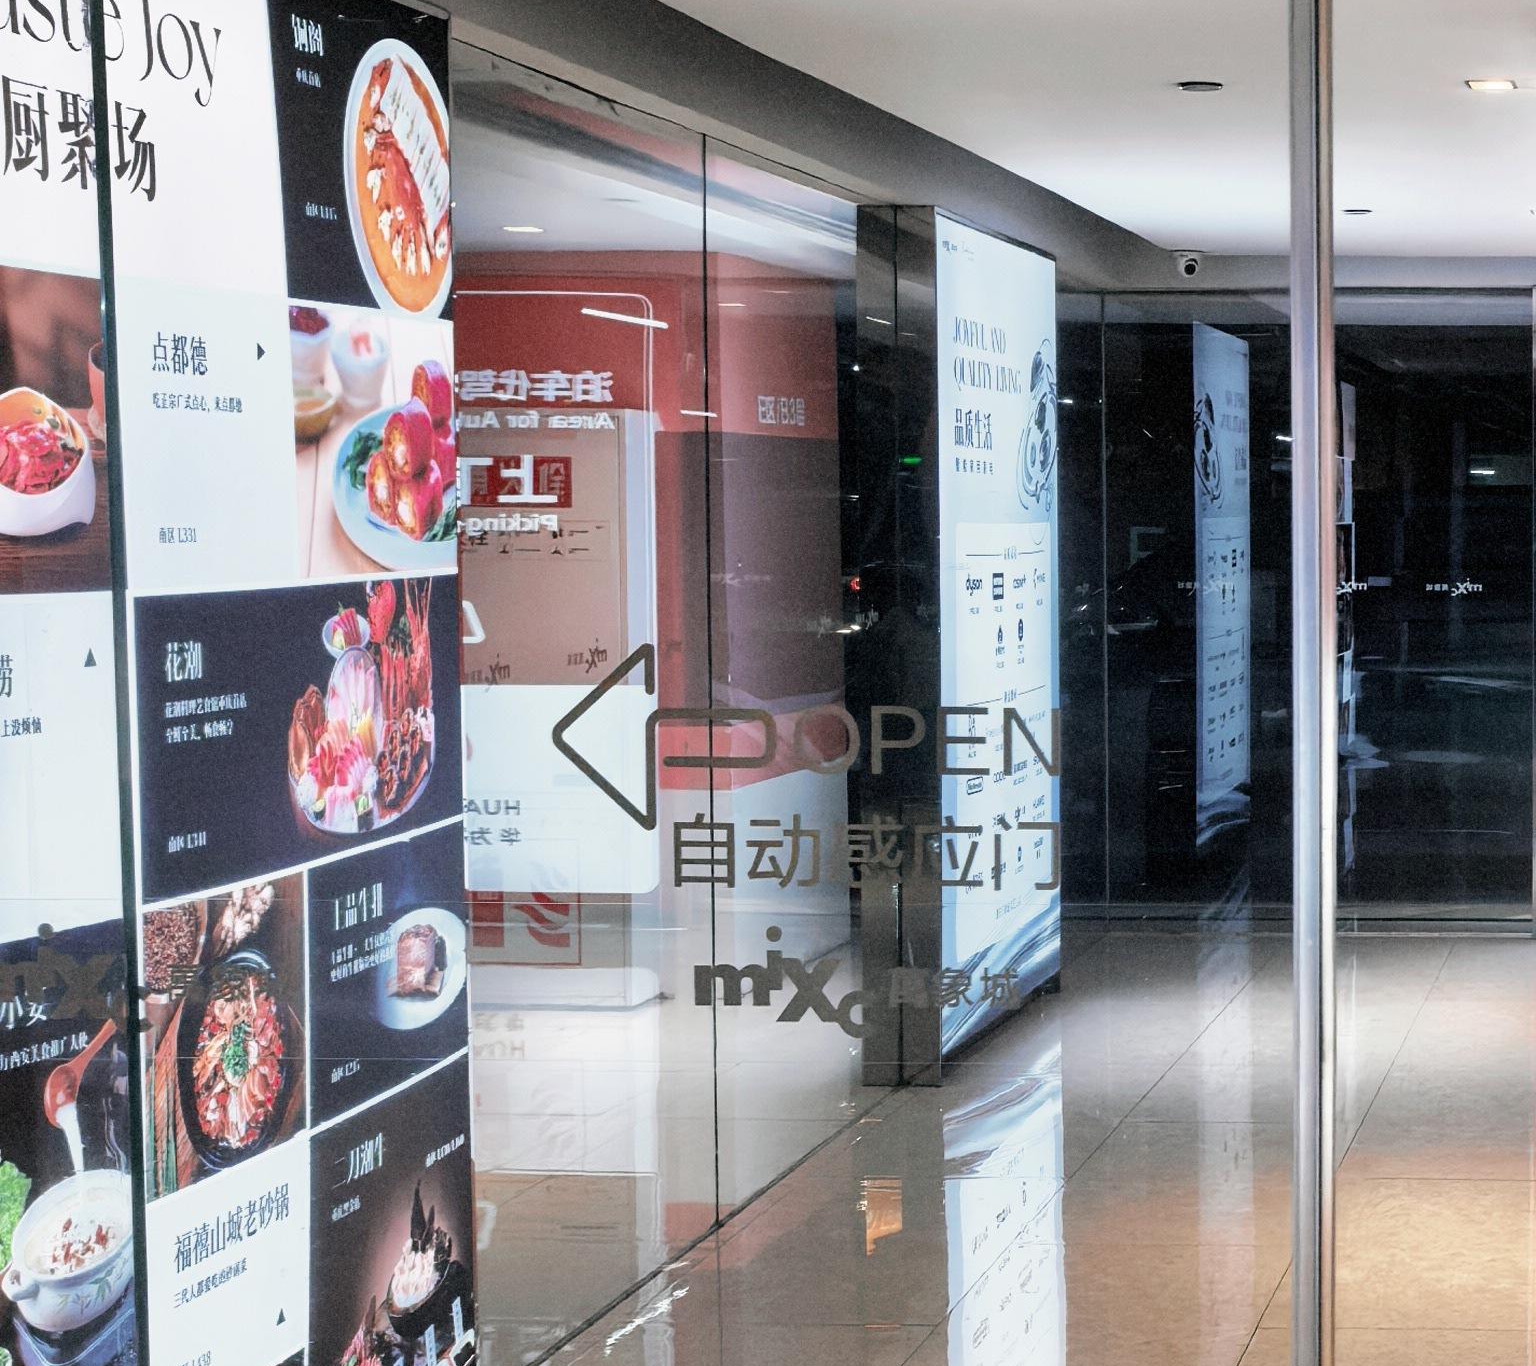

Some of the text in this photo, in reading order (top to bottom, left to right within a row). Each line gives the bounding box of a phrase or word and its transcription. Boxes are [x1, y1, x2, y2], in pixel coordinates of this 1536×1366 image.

[151, 331, 209, 377] 点都德
[953, 357, 1022, 395] QUALITY LIVING
[954, 407, 994, 452] 品质生活
[164, 639, 203, 684] 花潮
[793, 705, 1062, 777] OPEN
[672, 812, 1062, 892] 自动感应门
[693, 926, 870, 1040] mixc
[173, 1182, 290, 1275] 福禧山城老砂锅
